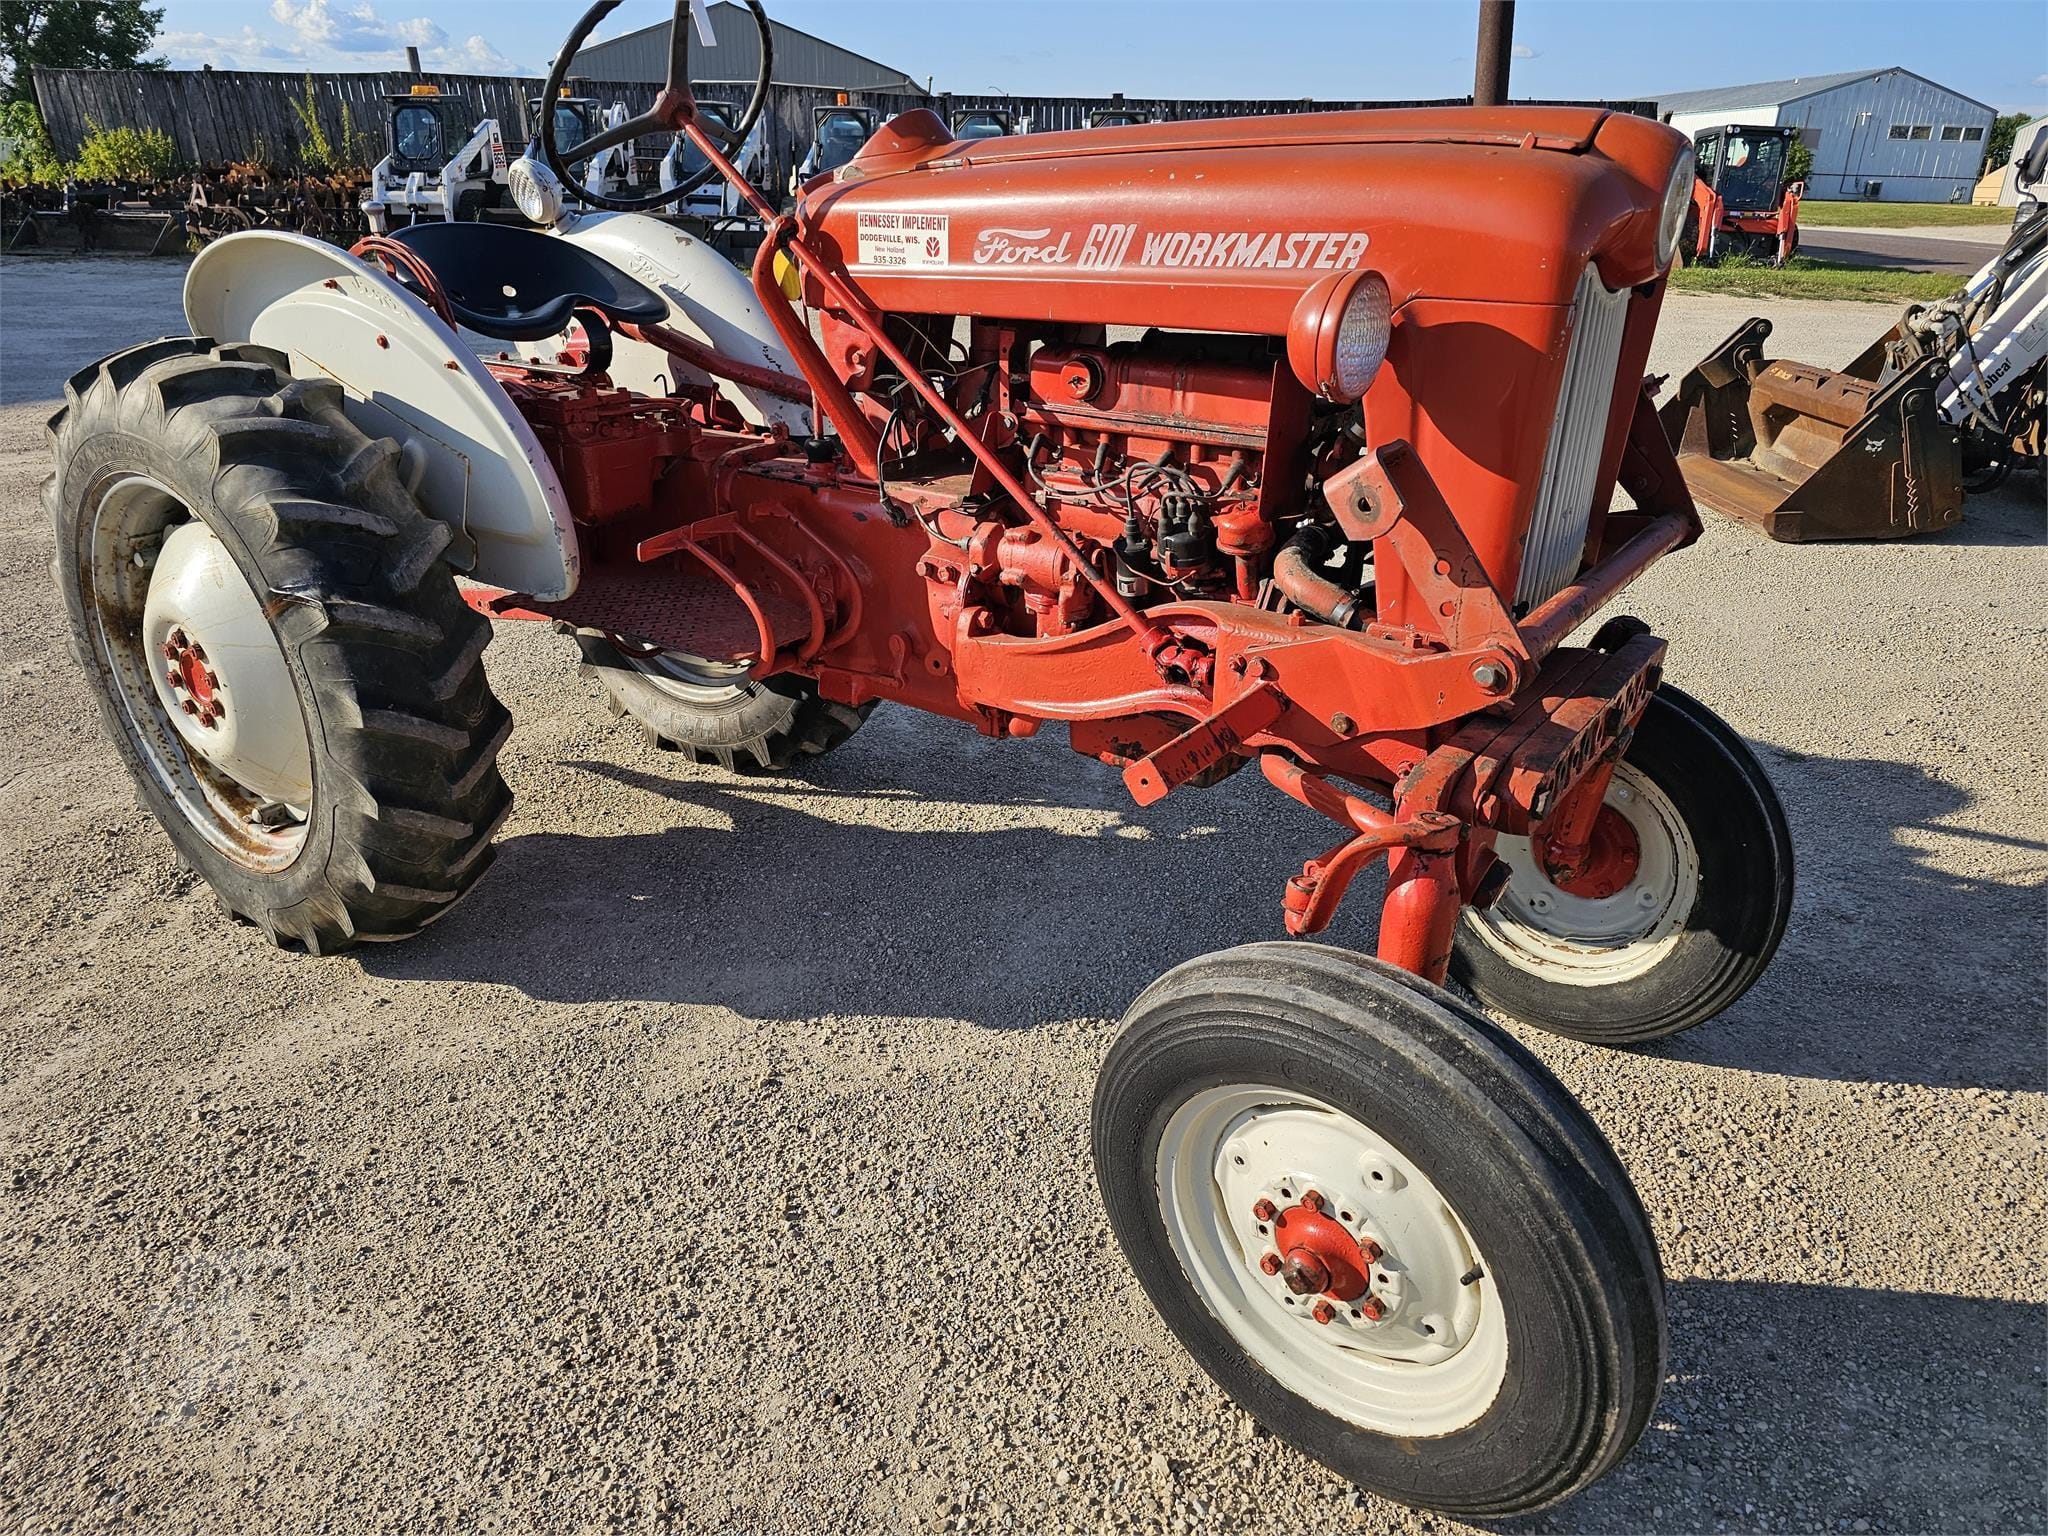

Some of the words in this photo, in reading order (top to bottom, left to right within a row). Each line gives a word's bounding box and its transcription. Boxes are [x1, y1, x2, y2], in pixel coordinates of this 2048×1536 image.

[859, 213, 900, 229] HENNESSEY
[902, 215, 947, 231] IMPLEMENT
[860, 233, 904, 245] DODGEVILLE,
[904, 235, 921, 245] WIS.
[874, 245, 886, 253] New
[886, 246, 905, 254] Holland
[973, 227, 1072, 264] Ford
[1076, 223, 1138, 272] 601
[1139, 232, 1370, 270] WORKMASTER
[873, 255, 907, 266] 935-3326
